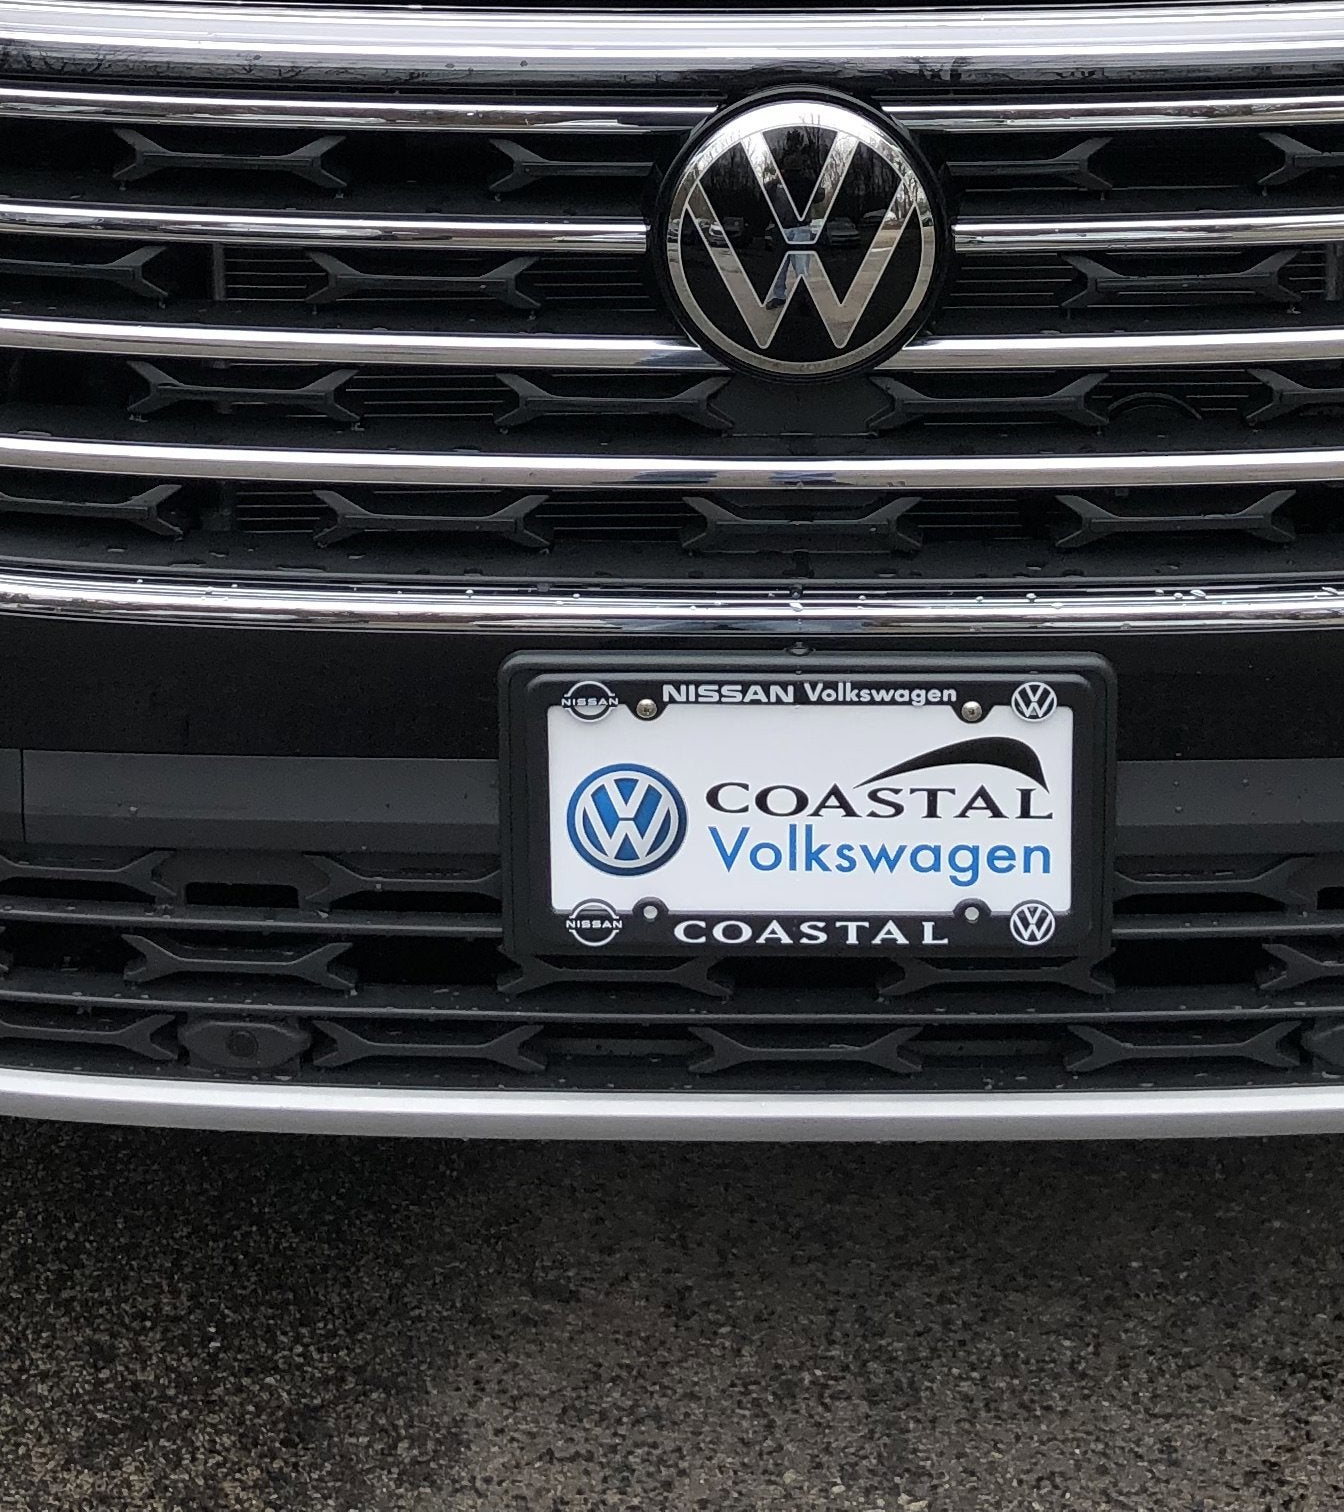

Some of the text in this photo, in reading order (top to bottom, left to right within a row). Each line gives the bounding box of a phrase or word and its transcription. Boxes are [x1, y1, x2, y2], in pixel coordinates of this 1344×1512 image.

[561, 696, 619, 707] NISSAN
[662, 682, 958, 706] NISSAN Volkswagen
[705, 782, 1053, 819] COASTAL
[708, 823, 1052, 887] Volkswagen
[565, 919, 623, 930] NISSAN
[672, 919, 949, 946] COASTAL
